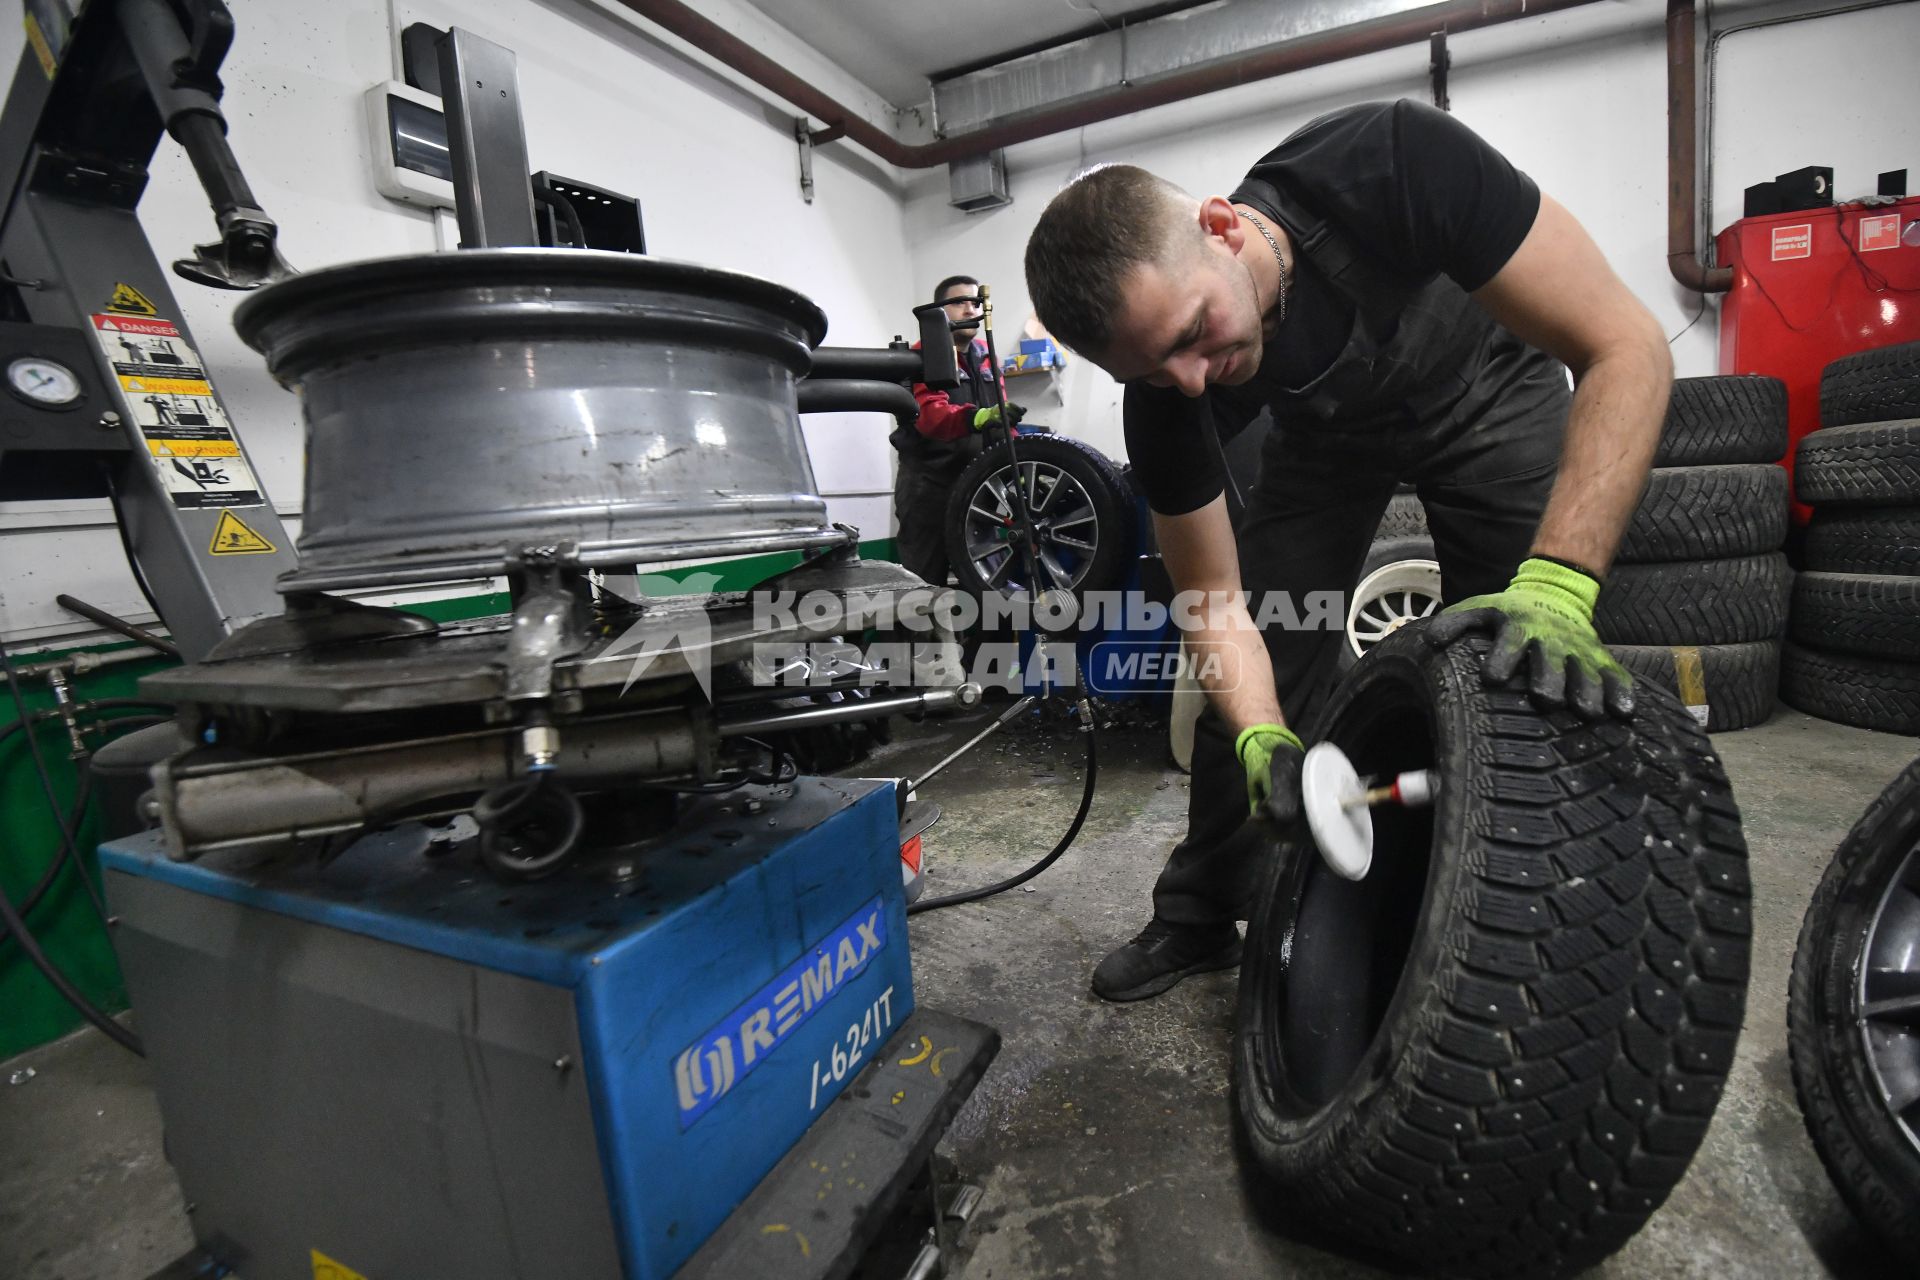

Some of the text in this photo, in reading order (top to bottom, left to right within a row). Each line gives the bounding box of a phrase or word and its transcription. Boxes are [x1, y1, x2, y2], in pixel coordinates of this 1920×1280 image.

[120, 322, 180, 336] DANGER
[145, 382, 208, 394] WARNING
[174, 446, 238, 456] WARNING
[740, 911, 880, 1067] REMAX
